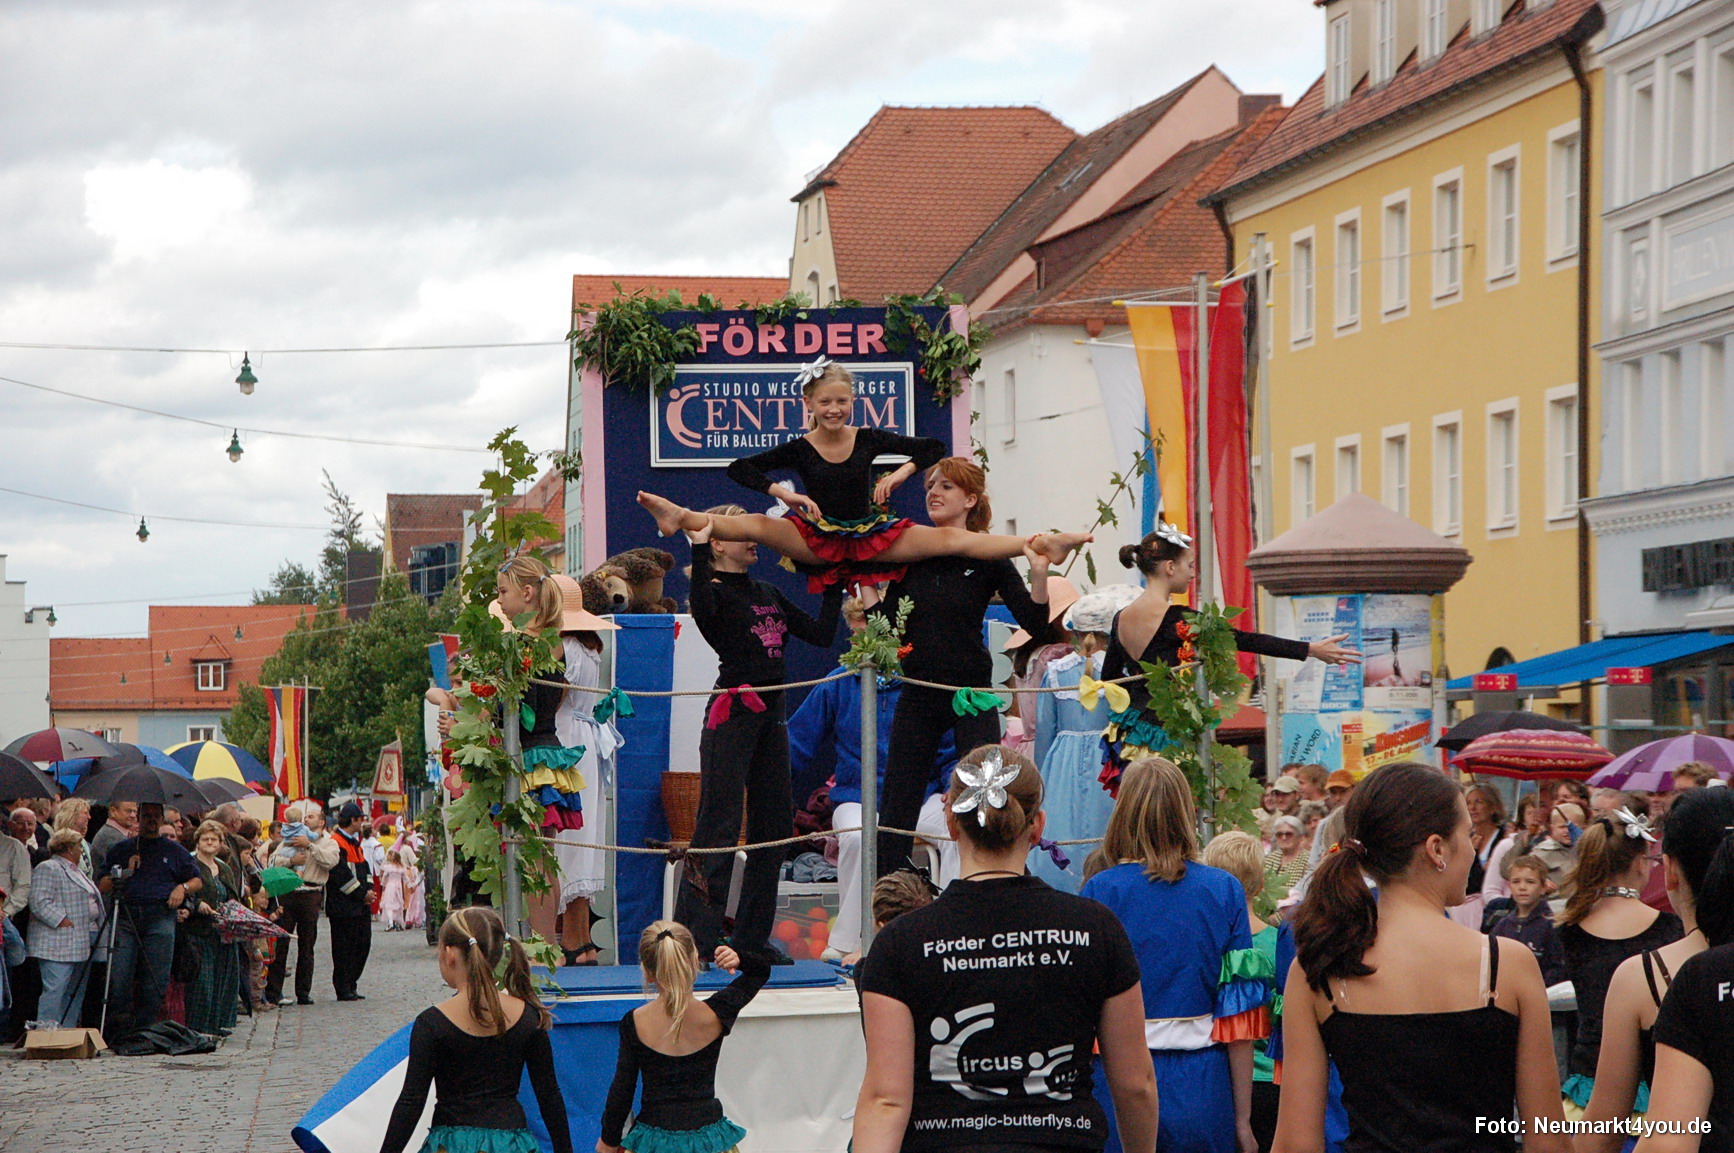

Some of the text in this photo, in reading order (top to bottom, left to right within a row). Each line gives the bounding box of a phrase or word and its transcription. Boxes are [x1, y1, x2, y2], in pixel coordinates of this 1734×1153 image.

[696, 318, 888, 356] FÖRDER
[703, 382, 760, 397] STUDIO
[706, 431, 729, 448] FÜR
[733, 433, 780, 448] BALLETT
[1303, 728, 1322, 755] WORD
[923, 929, 1090, 958] Förder CENTRUM
[942, 950, 1073, 973] Neumarkt e.V.
[914, 1113, 1092, 1131] www.magic-butterflys.de
